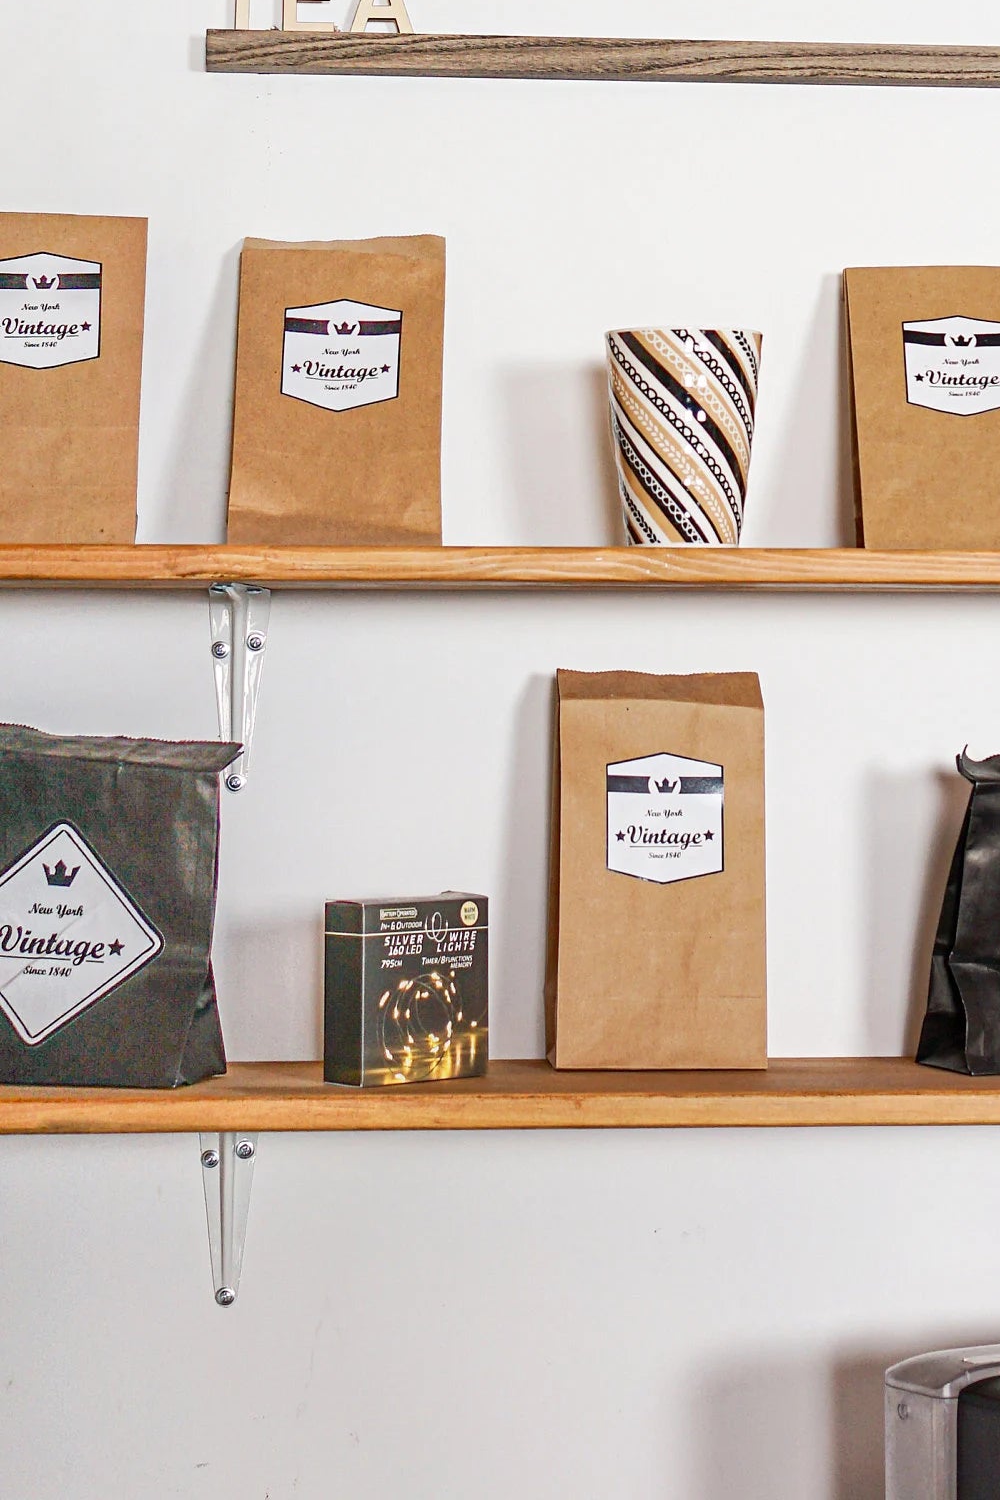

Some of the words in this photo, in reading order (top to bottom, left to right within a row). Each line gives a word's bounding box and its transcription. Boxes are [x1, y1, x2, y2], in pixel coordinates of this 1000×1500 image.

[21, 303, 38, 311] New
[40, 303, 60, 312] York
[2, 317, 79, 340] Vintage
[340, 348, 361, 357] York
[960, 358, 980, 367] York
[303, 360, 378, 383] Vintage
[925, 369, 1000, 390] Vintage
[663, 809, 683, 819] York
[627, 825, 702, 850] Vintage
[28, 903, 53, 915] New
[56, 904, 84, 919] York
[384, 934, 424, 946] SILVER
[449, 931, 477, 942] WIRE
[0, 924, 105, 966] Vintage
[388, 946, 404, 956] 160
[405, 945, 422, 954] LED
[437, 941, 475, 953] LIGHTS
[23, 965, 47, 976] Since
[48, 967, 73, 978] 1840
